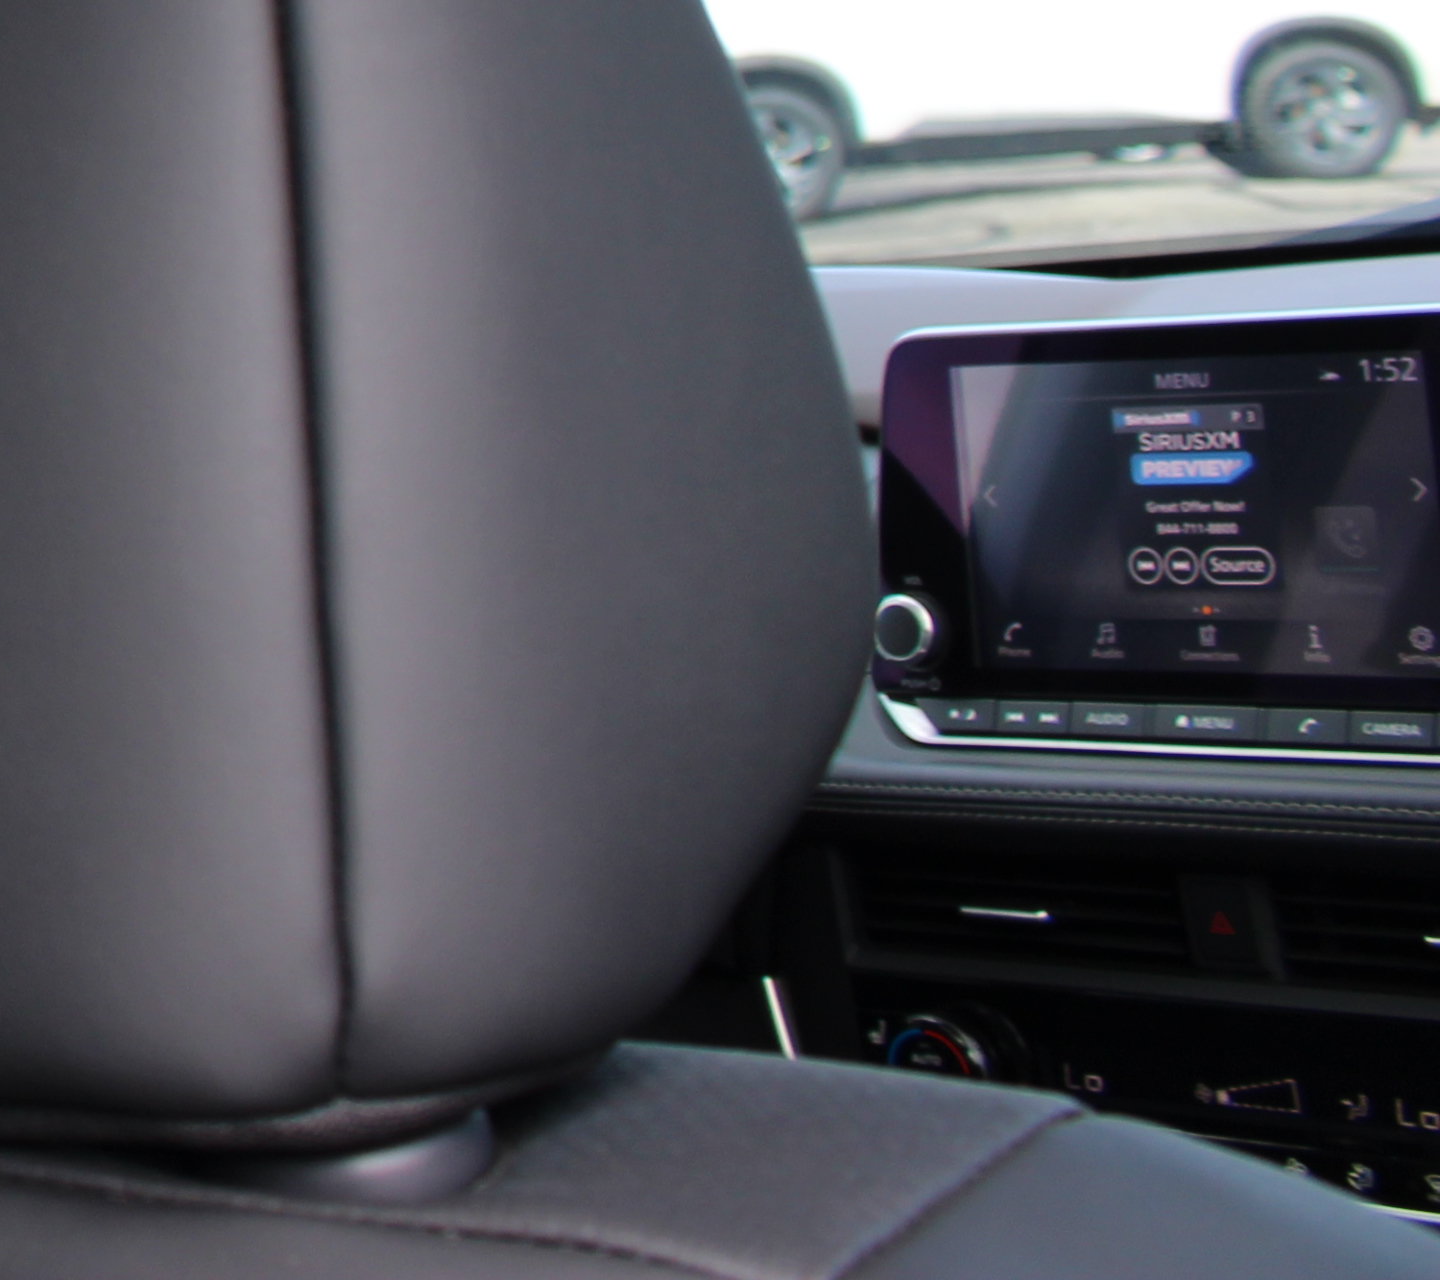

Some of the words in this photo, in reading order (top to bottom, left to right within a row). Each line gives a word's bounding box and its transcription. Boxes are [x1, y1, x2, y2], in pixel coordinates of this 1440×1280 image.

[1358, 356, 1419, 383] 1:52
[1153, 372, 1210, 390] MENU
[1138, 430, 1241, 452] SIRIUSXM
[1209, 556, 1266, 573] Source
[1084, 712, 1130, 726] AUDIO
[1361, 721, 1423, 737] CAMERA
